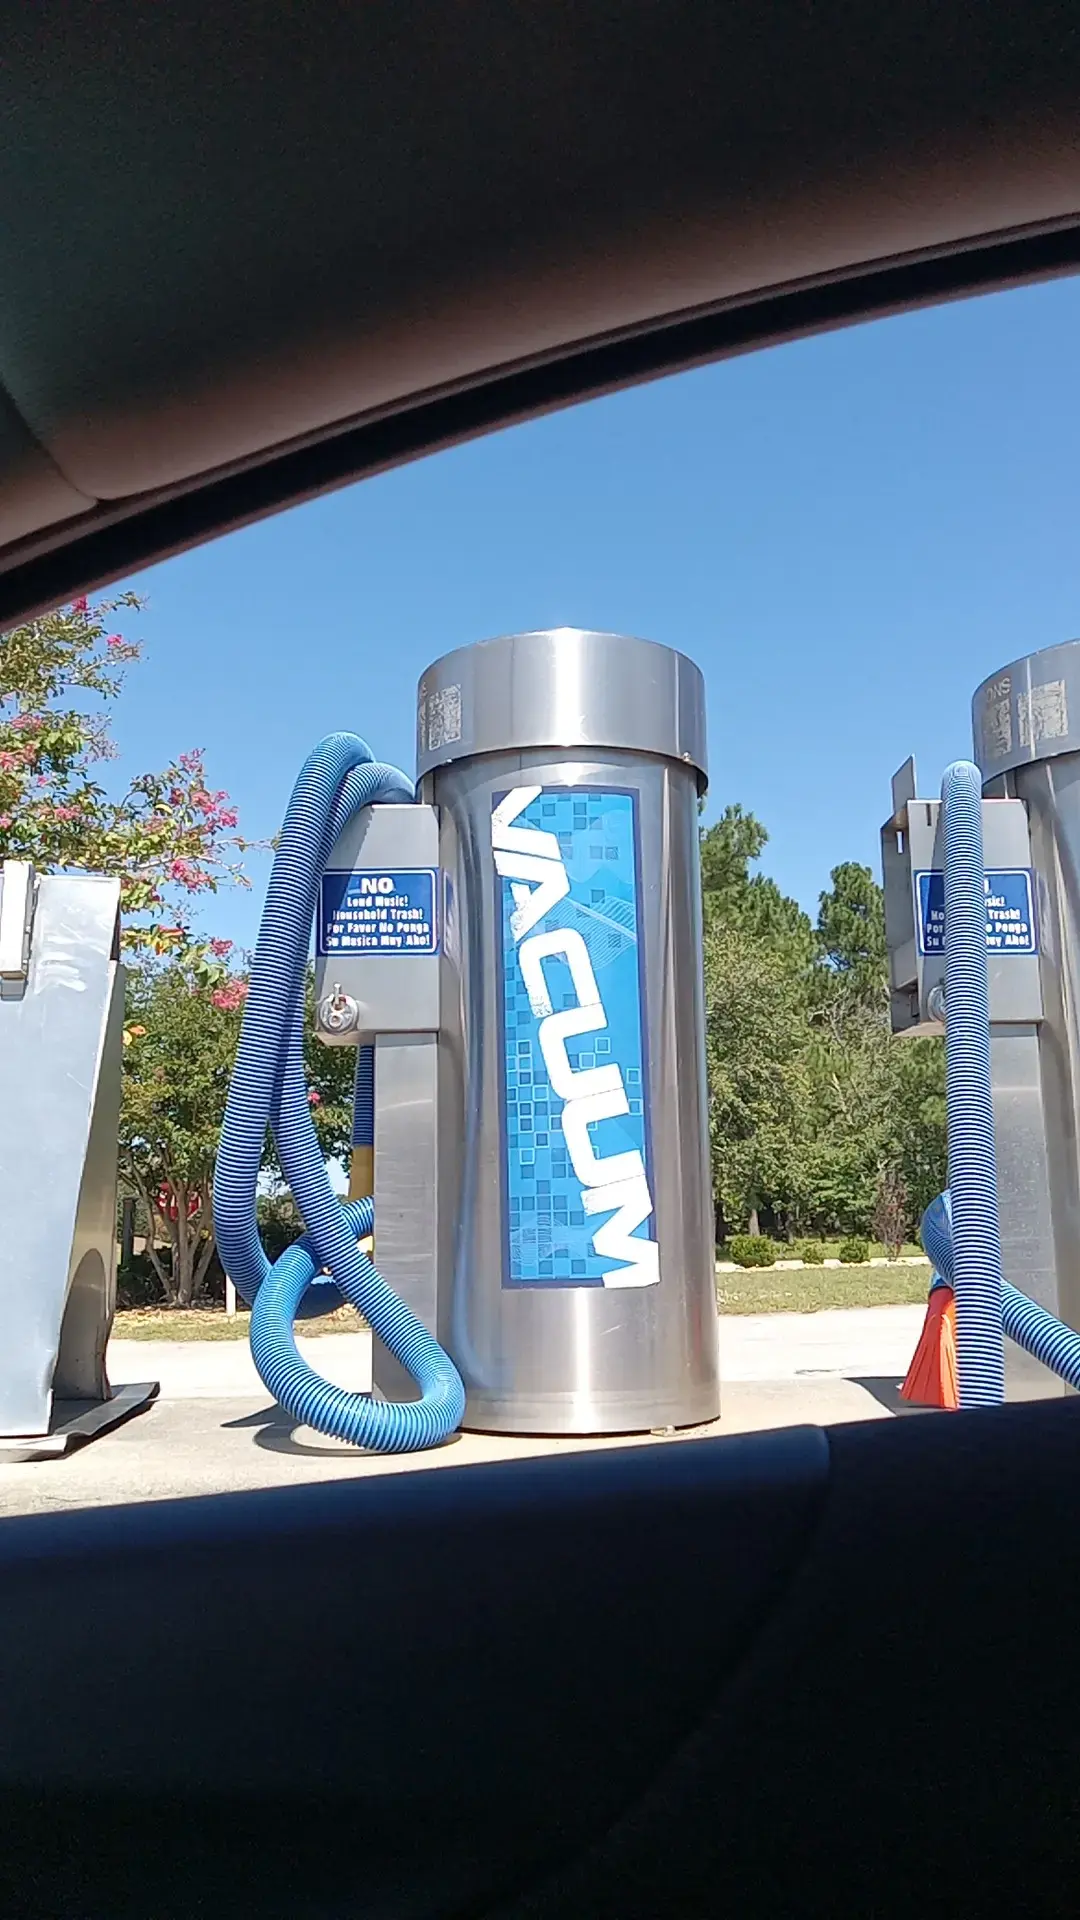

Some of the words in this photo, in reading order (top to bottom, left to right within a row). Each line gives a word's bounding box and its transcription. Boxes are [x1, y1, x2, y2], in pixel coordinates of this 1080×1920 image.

[361, 877, 394, 894] NO
[347, 896, 373, 907] Loud
[375, 895, 408, 907] Music!
[332, 909, 388, 920] Household
[390, 908, 423, 920] Trash!
[988, 908, 1021, 920] Trash!
[347, 922, 377, 933] Favor
[379, 922, 394, 933] No
[397, 922, 429, 934] Ponga
[995, 922, 1028, 934] Ponga
[326, 936, 339, 946] Su
[341, 935, 378, 946] Musica
[380, 935, 402, 947] Muy
[927, 936, 939, 946] Su
[491, 785, 660, 1288] VACUUM
